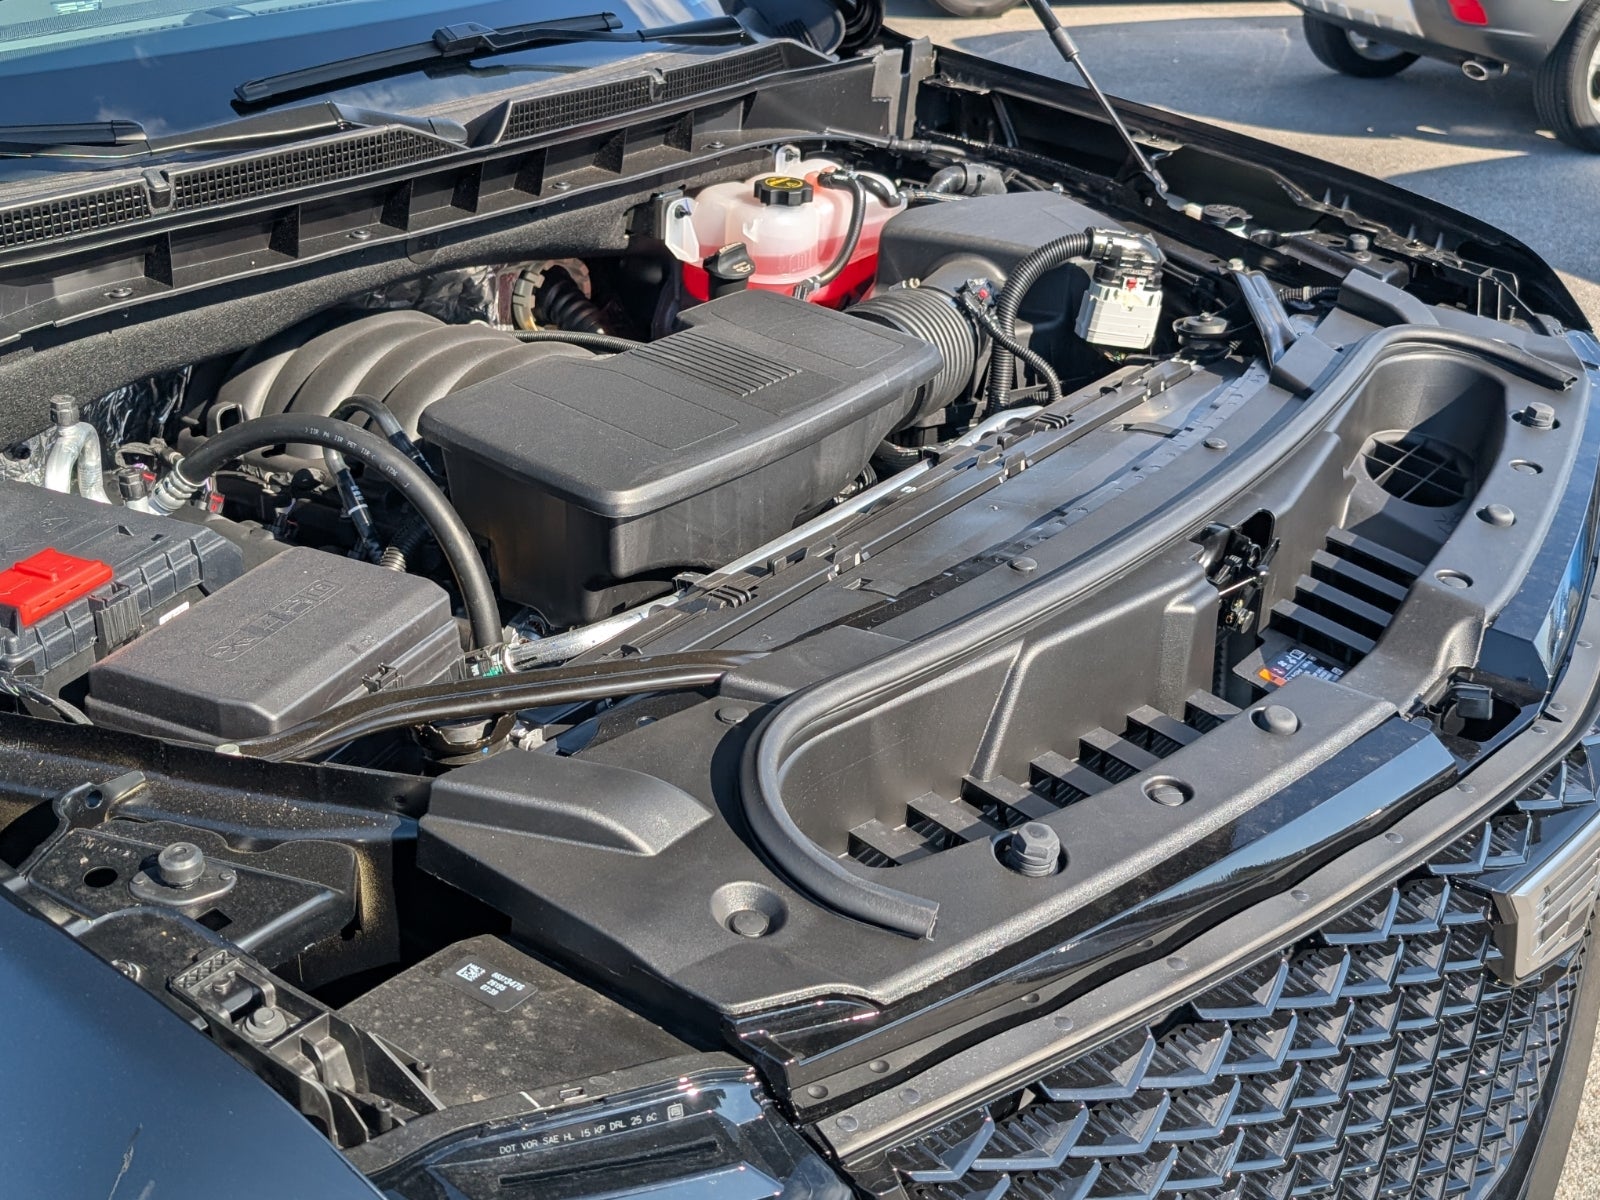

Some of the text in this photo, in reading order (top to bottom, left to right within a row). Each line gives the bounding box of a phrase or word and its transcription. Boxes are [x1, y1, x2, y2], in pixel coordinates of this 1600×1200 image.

[499, 1144, 516, 1155] DOT
[521, 1139, 539, 1150] VOR
[543, 1135, 560, 1146] SAE
[563, 1132, 575, 1142] HL
[609, 1120, 627, 1131] DRL
[630, 1115, 642, 1126] 25
